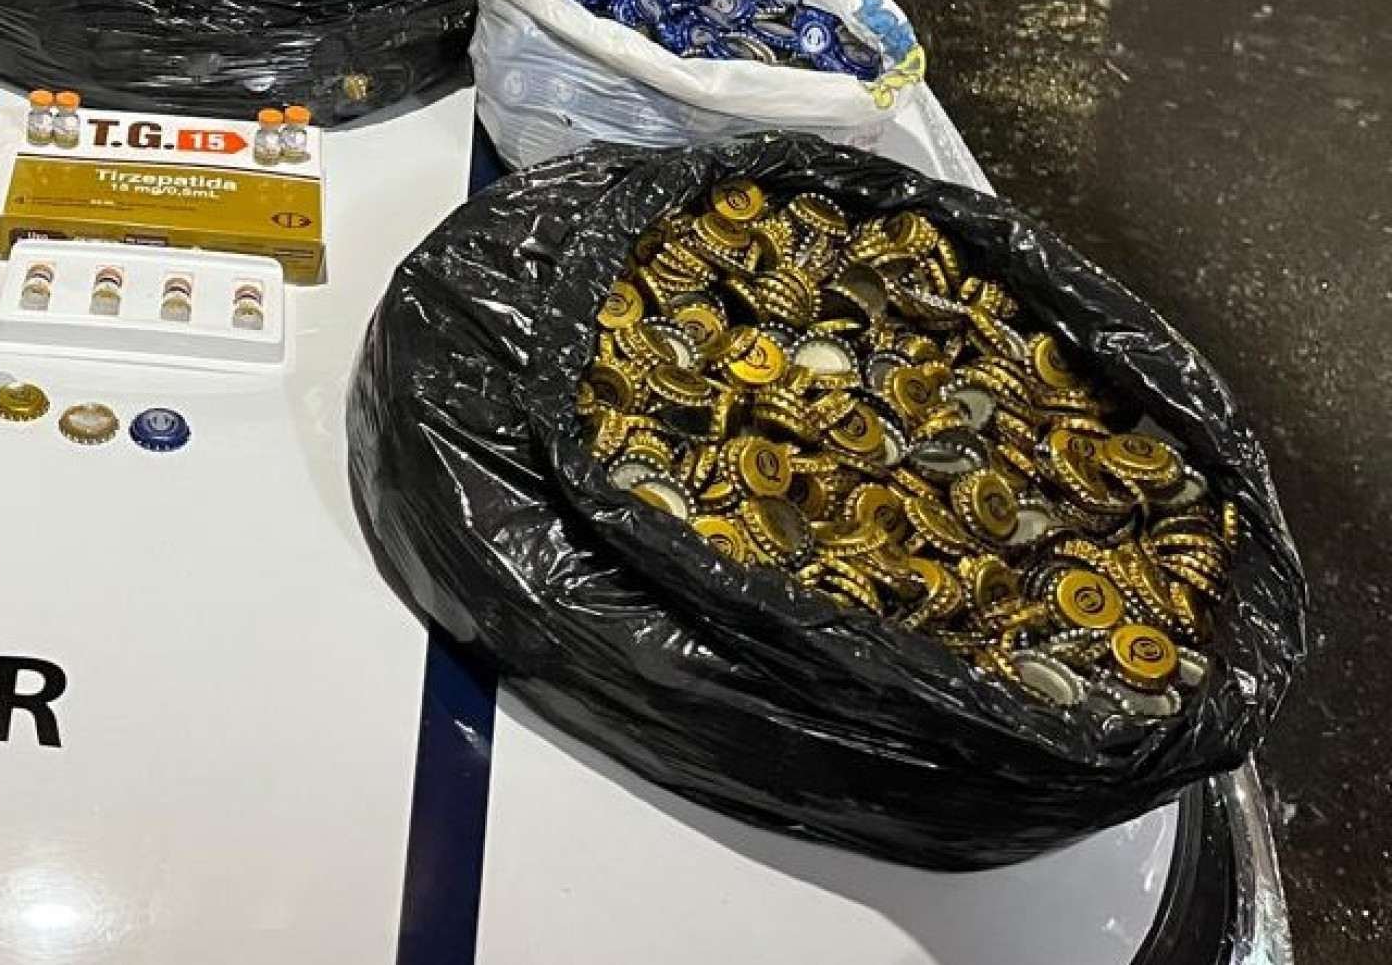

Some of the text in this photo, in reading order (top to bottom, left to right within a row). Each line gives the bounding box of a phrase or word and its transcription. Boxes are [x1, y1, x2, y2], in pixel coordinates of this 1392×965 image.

[87, 118, 225, 151] T.G. 15
[96, 168, 238, 192] Tirzepatida
